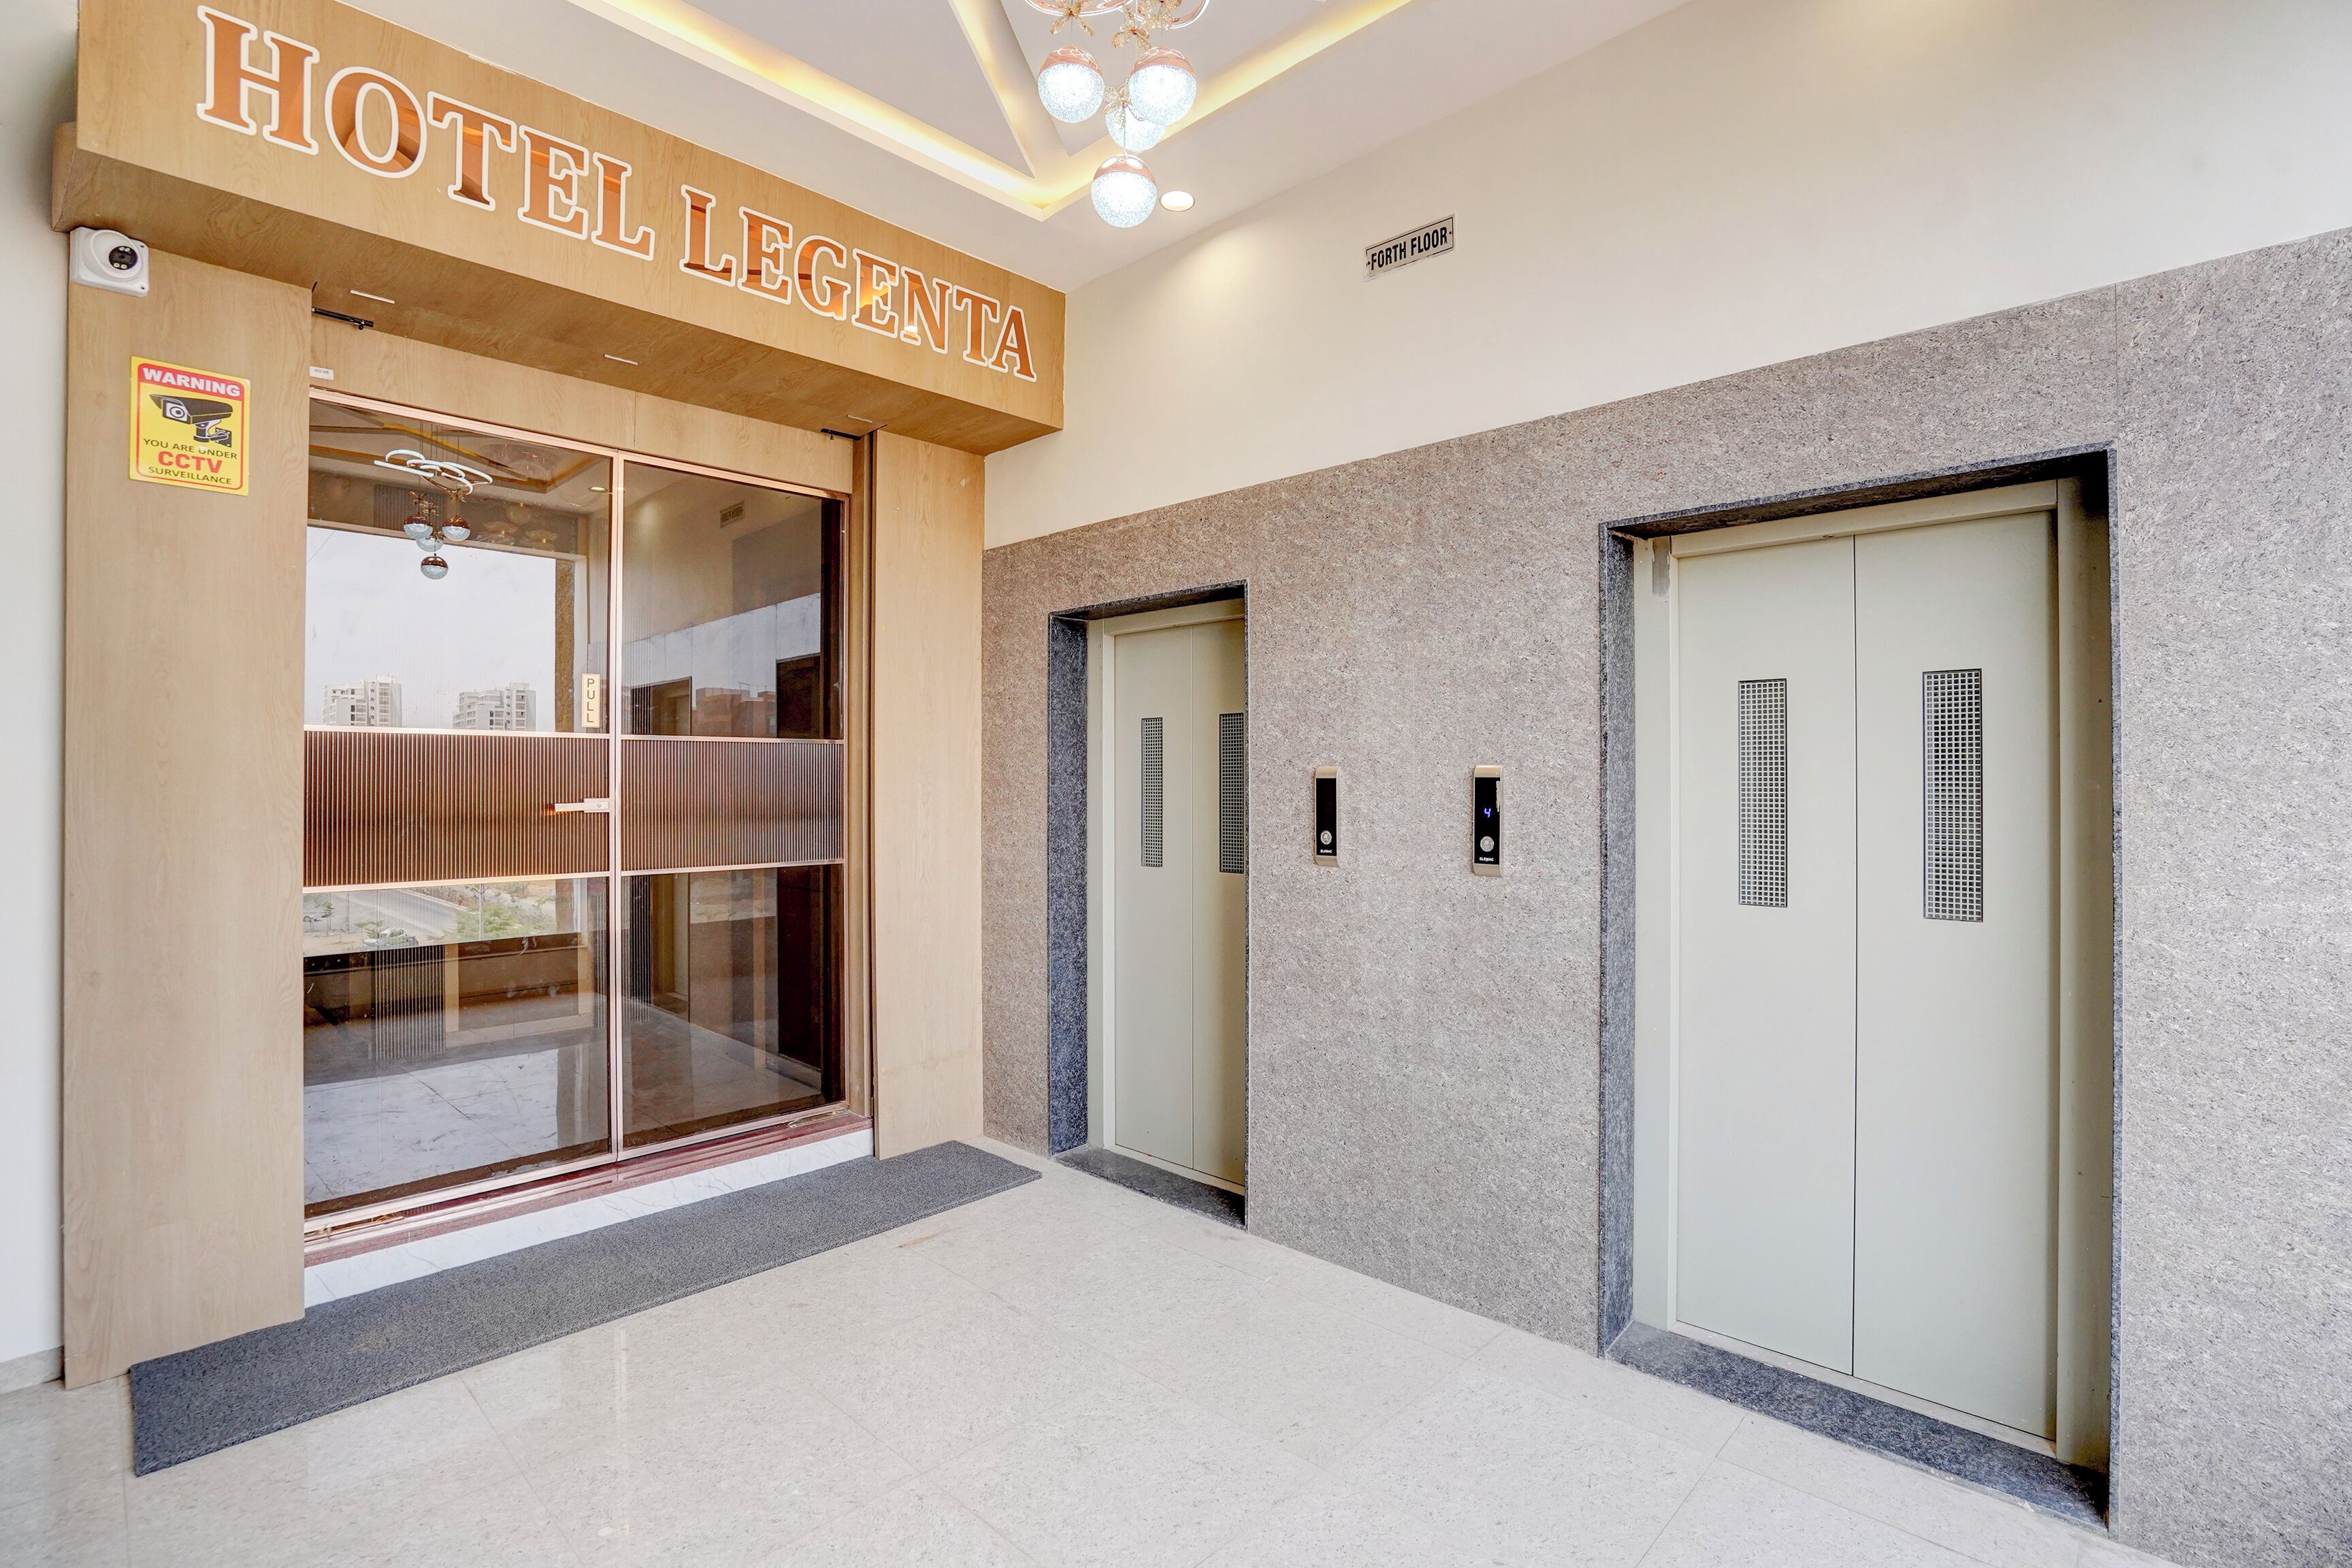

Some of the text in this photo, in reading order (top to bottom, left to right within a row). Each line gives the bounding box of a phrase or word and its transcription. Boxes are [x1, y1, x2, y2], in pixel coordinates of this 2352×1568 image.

[197, 5, 1037, 382] HOTEL LEGENTA
[1371, 227, 1448, 271] FORTH FLOOR
[142, 367, 240, 397] WARNING
[144, 438, 168, 448] YOU
[172, 443, 195, 453] ARE
[148, 466, 232, 485] SURVEILLANCE
[158, 451, 223, 474] CCTV
[587, 678, 595, 723] PULL
[1484, 808, 1491, 818] 4
